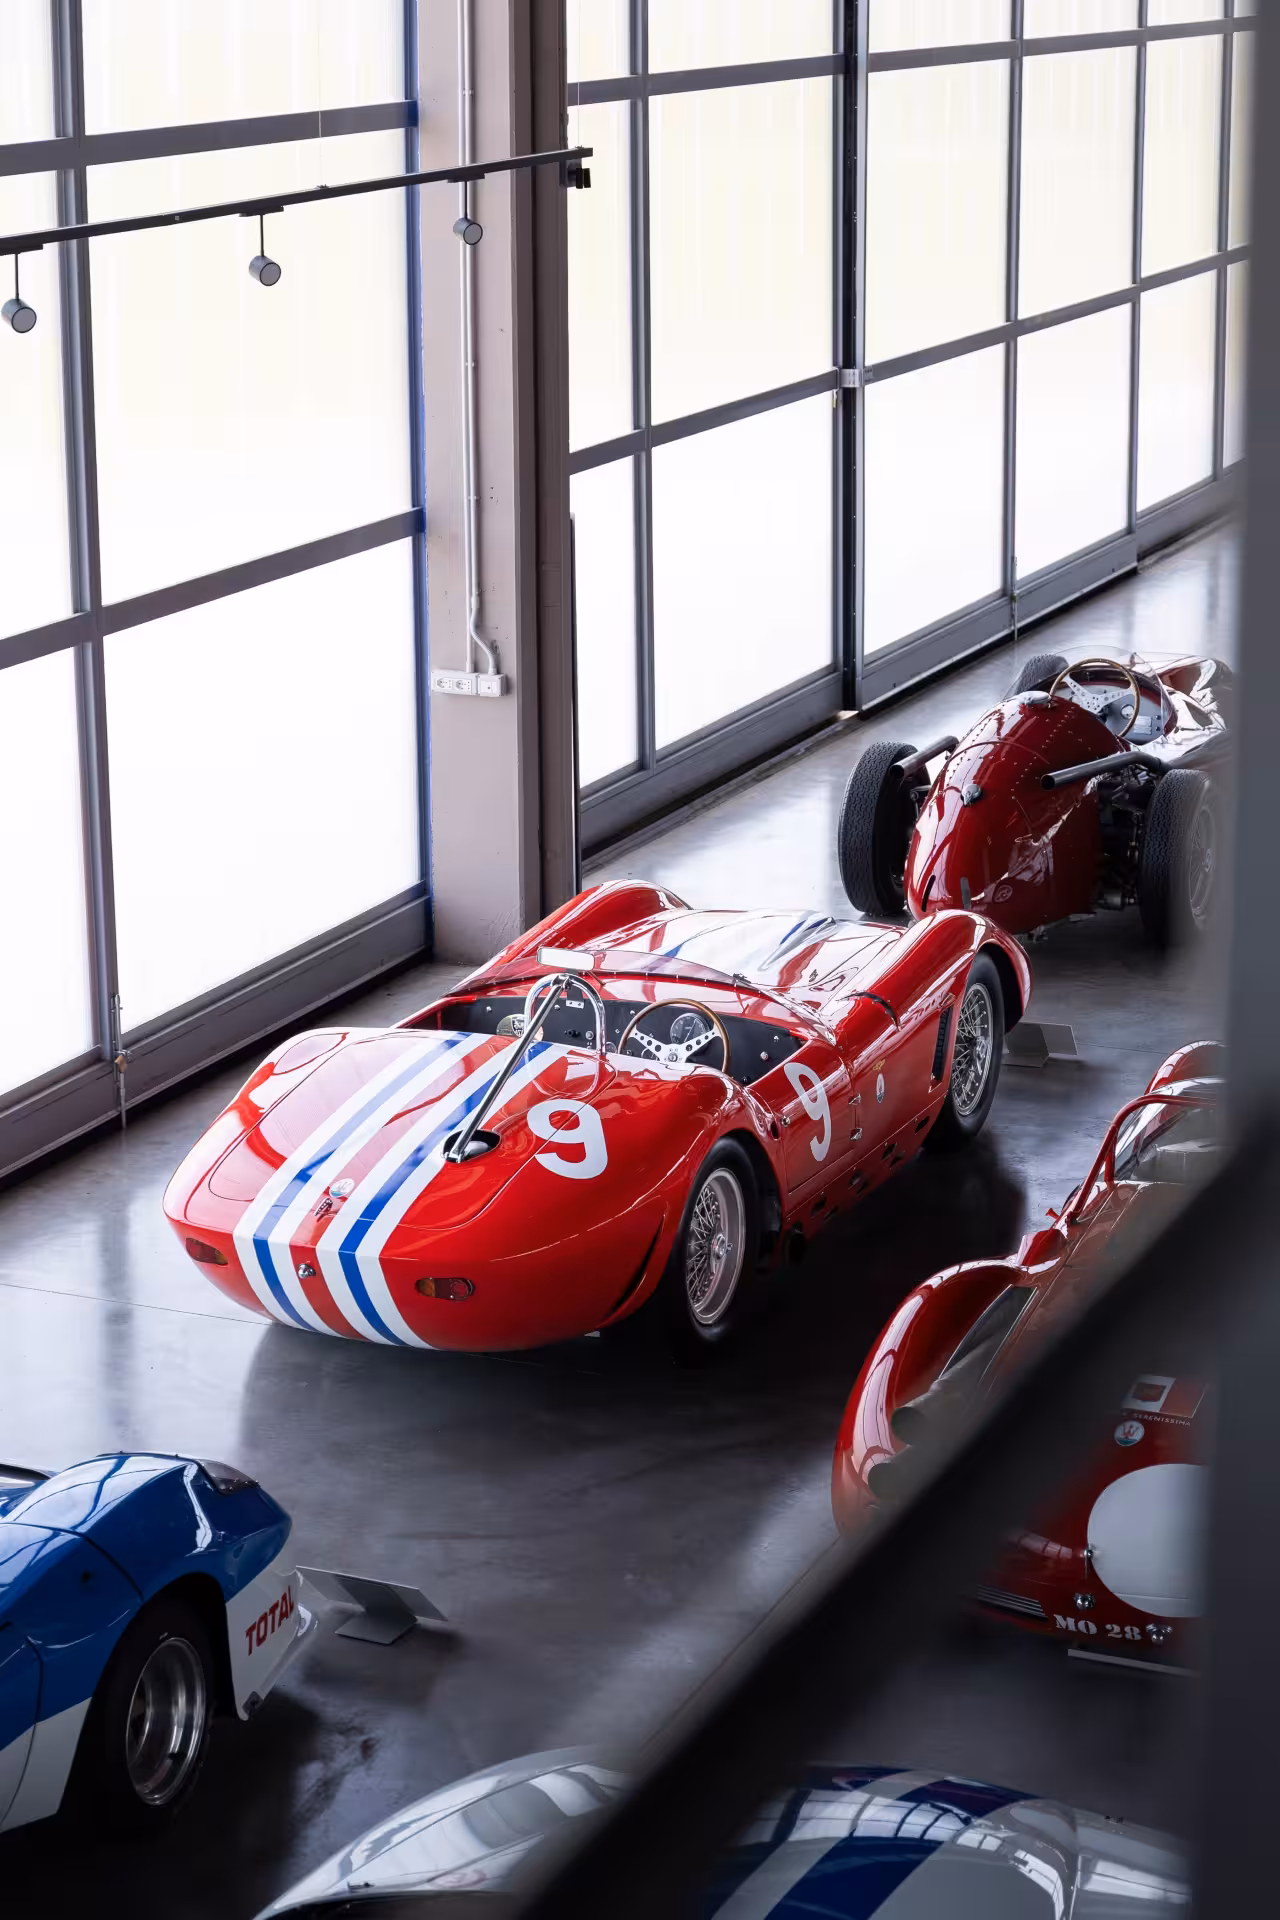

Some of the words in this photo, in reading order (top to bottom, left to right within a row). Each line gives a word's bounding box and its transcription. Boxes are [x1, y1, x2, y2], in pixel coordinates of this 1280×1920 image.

[526, 1098, 609, 1180] 9
[783, 1062, 832, 1161] 9
[245, 1585, 295, 1657] TOTAL
[1053, 1613, 1098, 1635] MO
